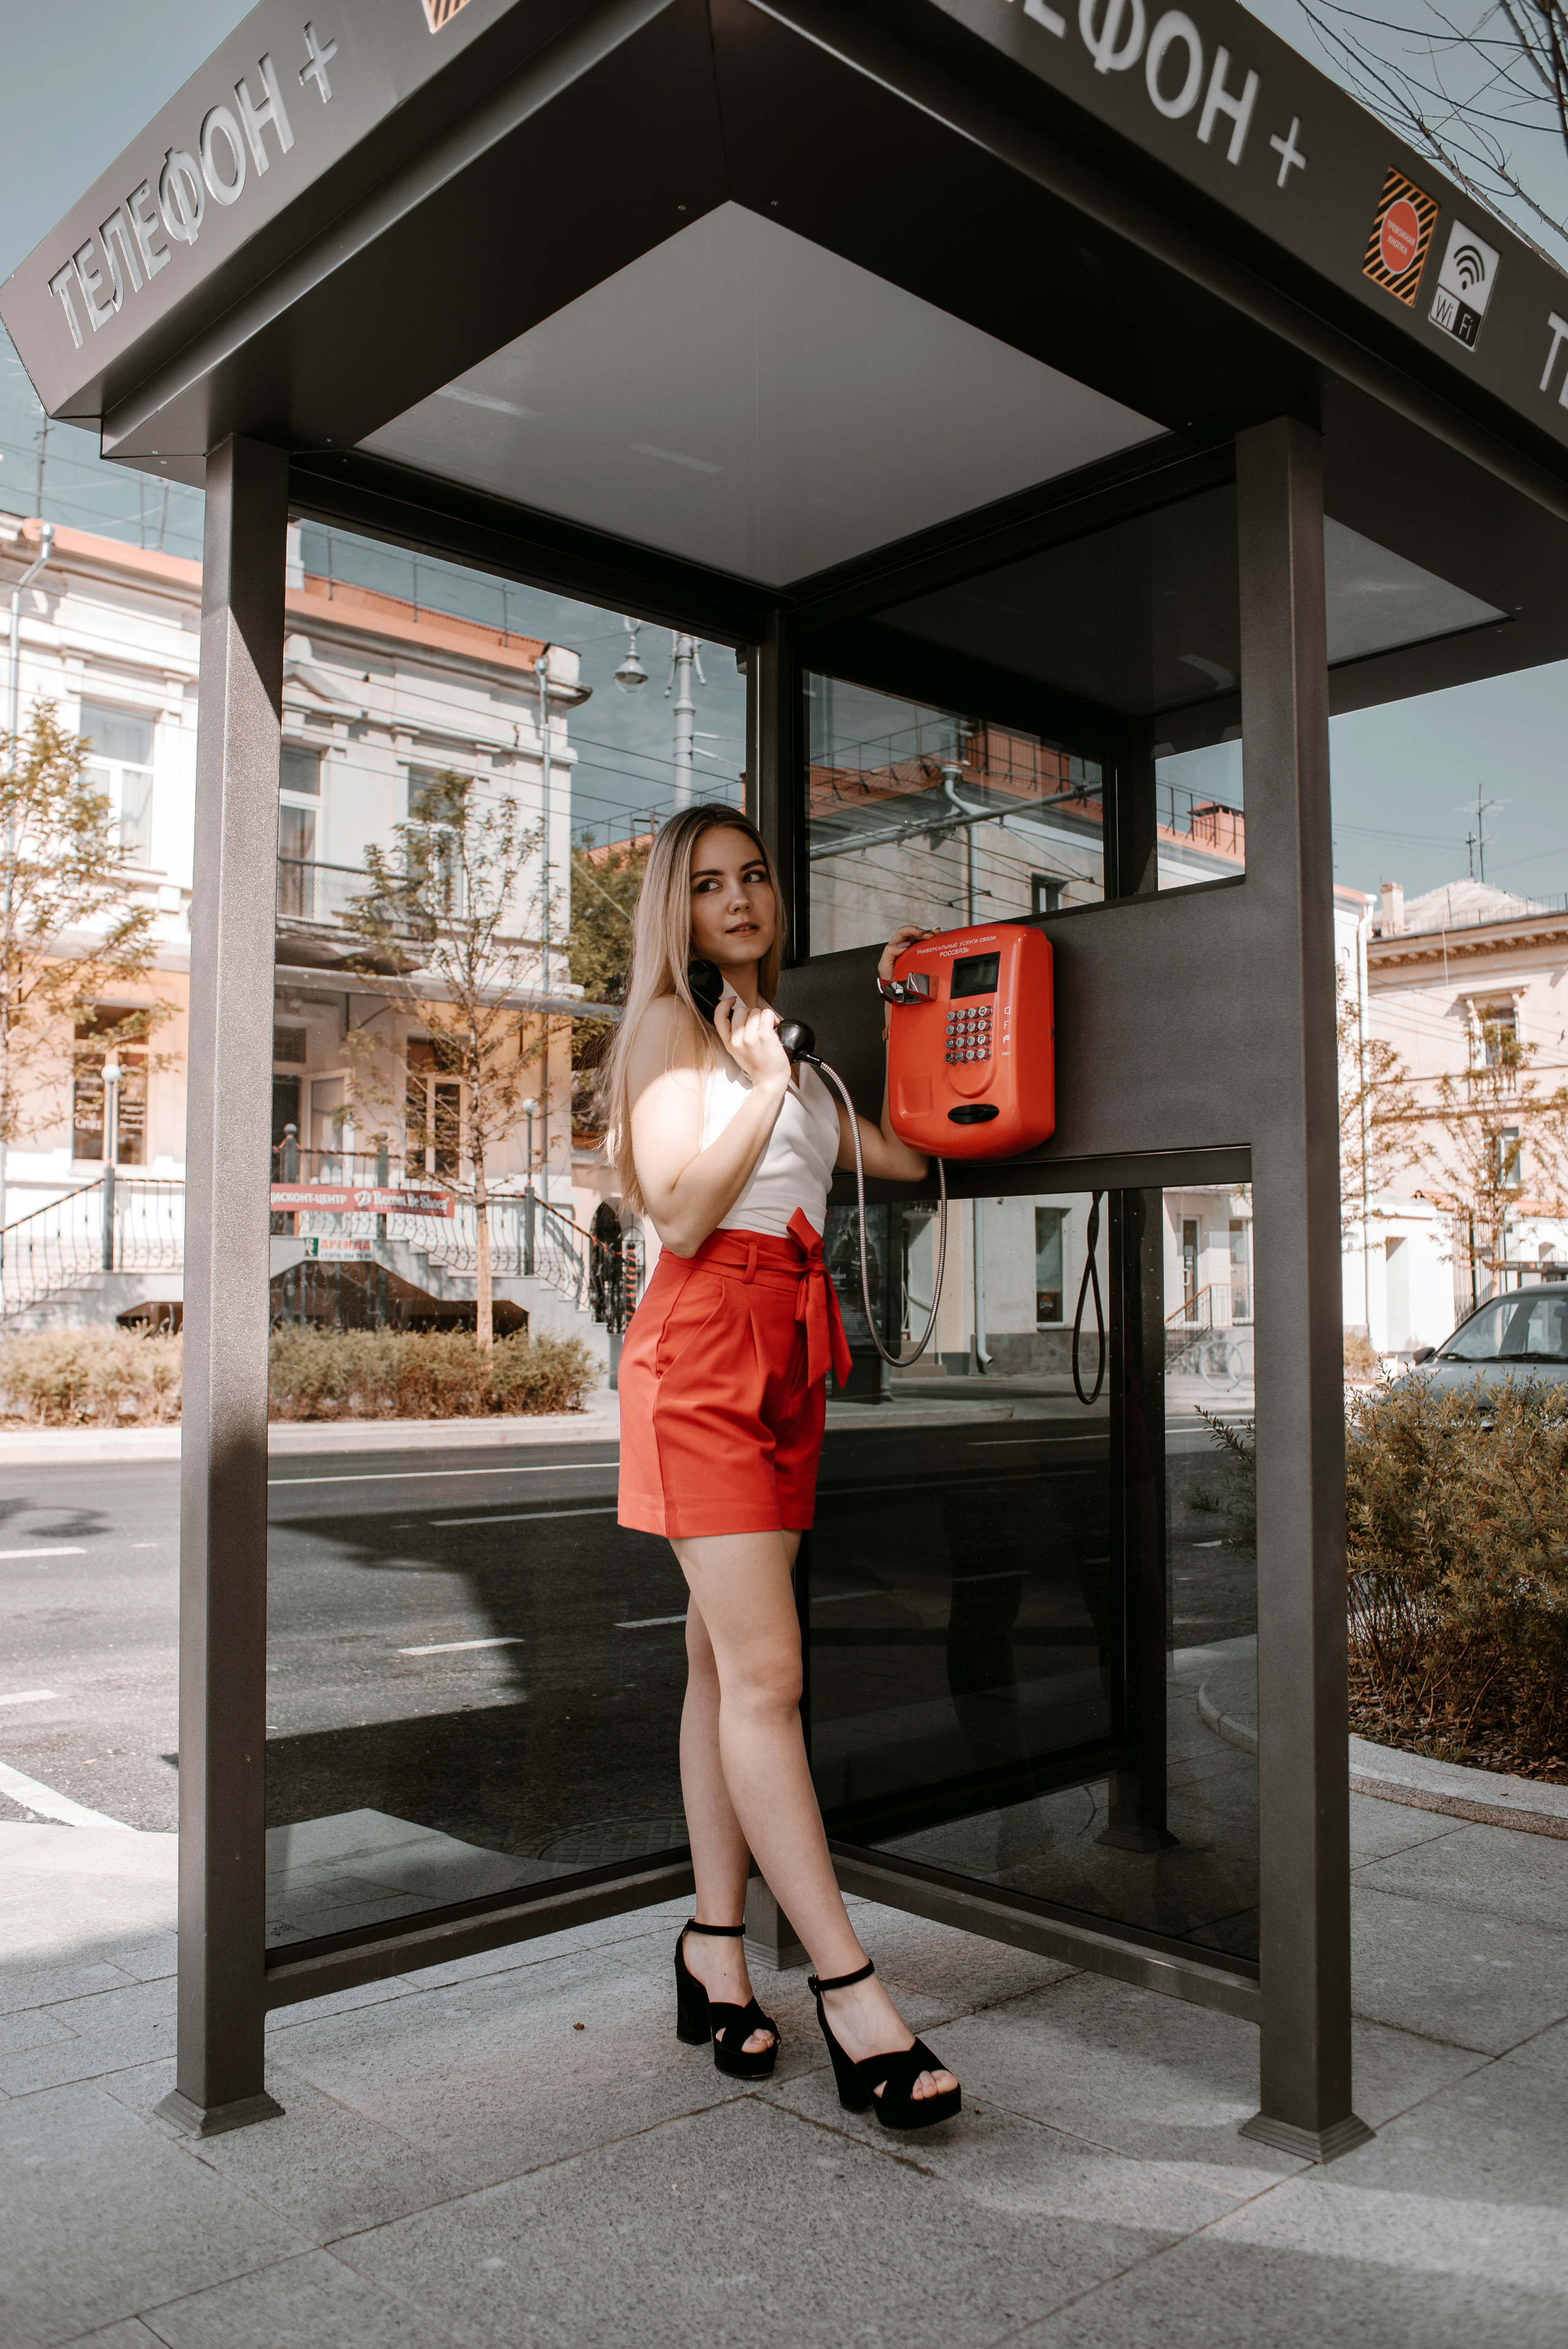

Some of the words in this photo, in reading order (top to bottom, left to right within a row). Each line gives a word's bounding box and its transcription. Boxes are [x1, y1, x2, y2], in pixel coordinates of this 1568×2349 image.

[48, 51, 295, 349] ТЕЛЕФОН
[1387, 219, 1415, 246] ТРЕВОЖНАЯ
[1387, 235, 1408, 255] КНОПКА
[1436, 295, 1453, 327] Wi
[1459, 313, 1472, 340] Fi
[940, 947, 969, 958] РОССВЯЗЬ
[322, 1239, 370, 1250] АРЕНДА
